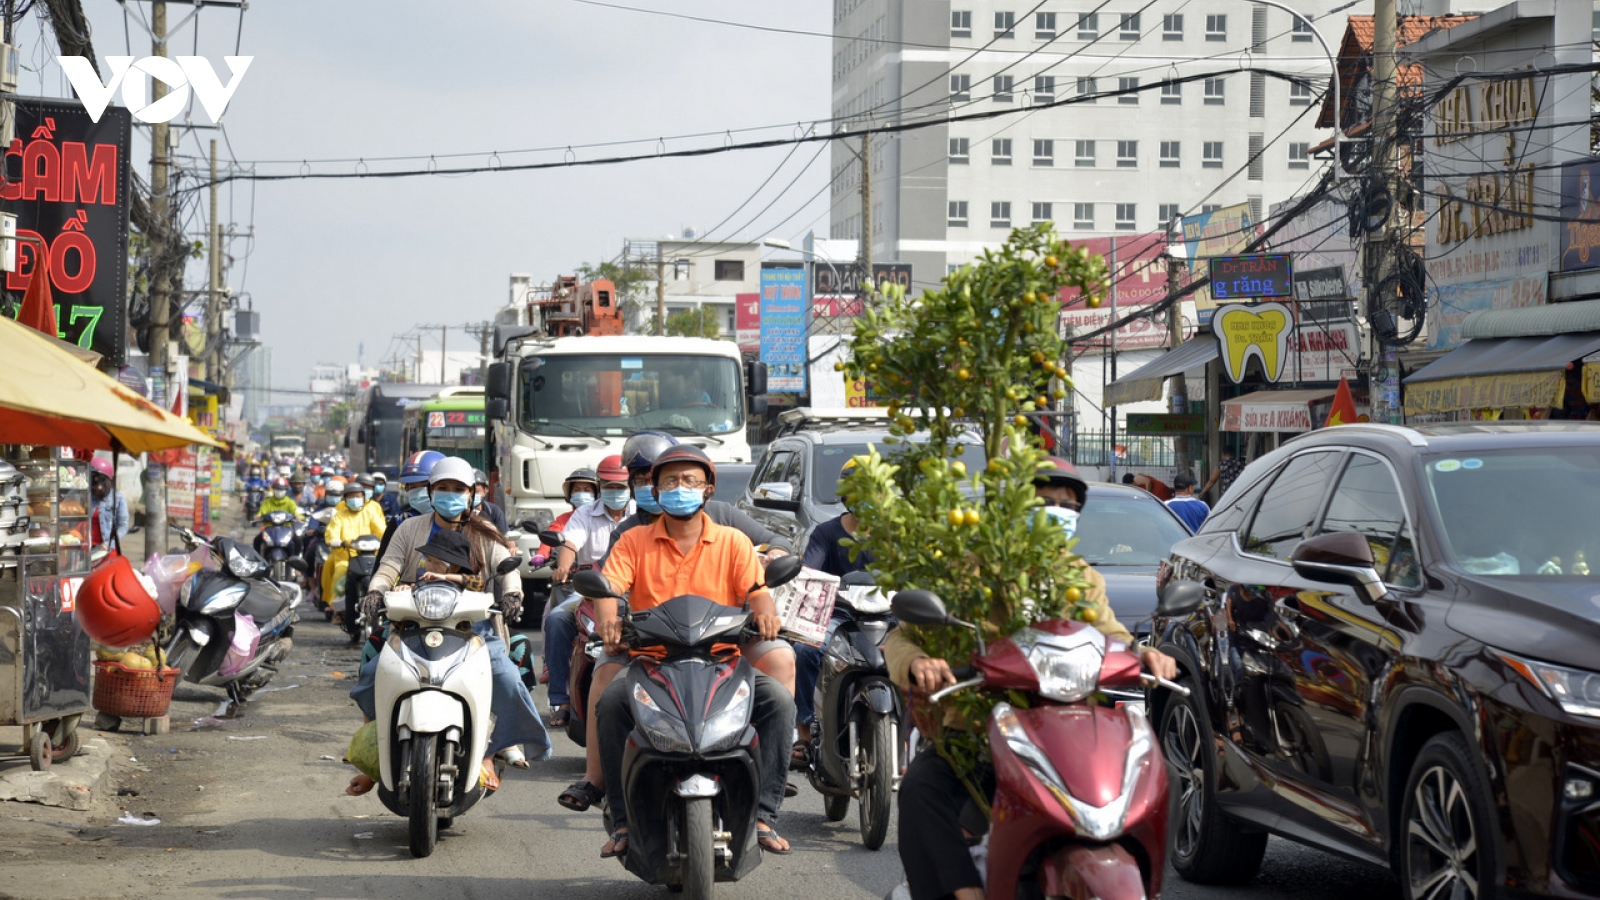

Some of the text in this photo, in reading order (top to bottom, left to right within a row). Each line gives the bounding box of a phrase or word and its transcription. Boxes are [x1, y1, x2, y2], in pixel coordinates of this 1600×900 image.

[1433, 65, 1537, 146] NHA KHOA
[0, 117, 117, 206] CẦM
[6, 209, 97, 294] ĐỒ
[1222, 262, 1238, 273] Dr
[1233, 275, 1274, 295] răng
[430, 413, 443, 427] 22
[447, 412, 465, 423] 22
